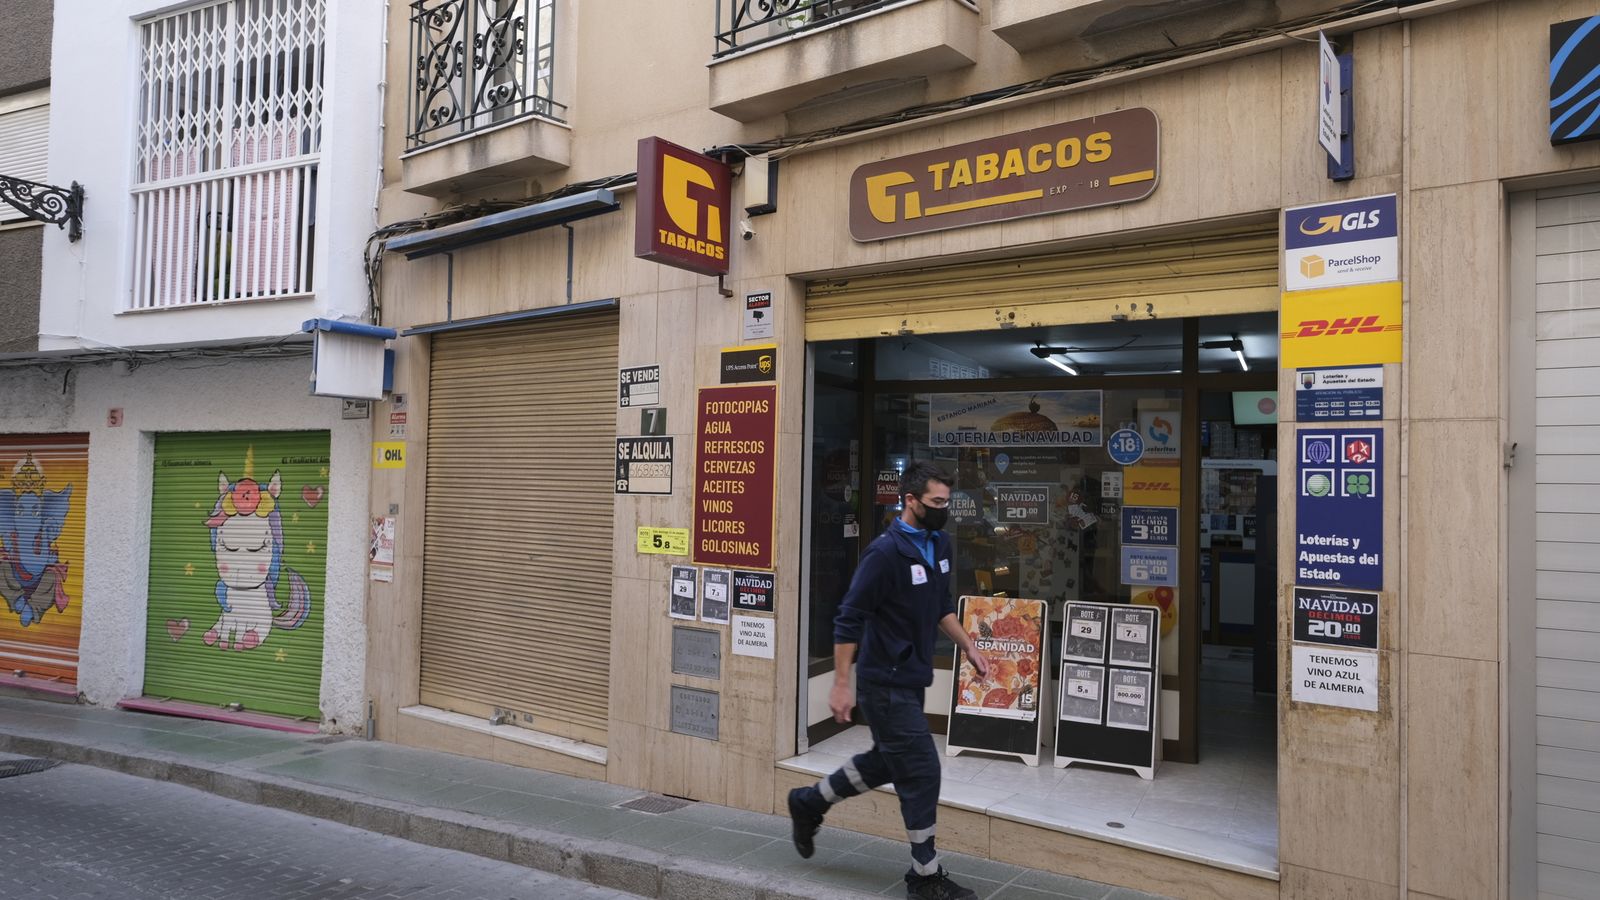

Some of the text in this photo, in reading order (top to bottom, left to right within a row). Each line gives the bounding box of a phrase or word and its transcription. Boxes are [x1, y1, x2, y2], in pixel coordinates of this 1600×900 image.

[928, 131, 1112, 191] TABACOS
[1050, 179, 1100, 196] EXP 18
[1342, 209, 1380, 231] GLS
[659, 229, 724, 260] TABACOS
[1328, 254, 1381, 267] ParcelShop
[748, 295, 769, 303] SECTOR
[1296, 315, 1385, 338] DHL
[760, 361, 771, 370] ups
[621, 368, 659, 384] SE VENDE
[706, 400, 768, 414] FOTOCOPIAS
[937, 398, 997, 422] ESTANCO MARIANA
[110, 409, 118, 425] 5
[647, 410, 657, 433] 7
[704, 421, 732, 434] AGUA
[937, 431, 1093, 443] LOTERIA DE NAVIDAD
[618, 441, 671, 461] SE ALQUILA
[704, 440, 765, 454] REFRESCOS
[1112, 437, 1136, 453] +18
[385, 449, 402, 461] OHL
[703, 461, 756, 474] CERVEZAS
[702, 480, 745, 494] ACEITES
[1131, 482, 1170, 491] DHL
[951, 497, 976, 509] TERÍA
[1000, 493, 1046, 502] NAVIDAD
[702, 500, 733, 513] VINOS
[949, 509, 977, 517] NAVIDAD
[702, 520, 745, 534] LICORES
[702, 539, 760, 555] GOLOSINAS
[1300, 534, 1360, 549] Loterías y
[1300, 551, 1378, 565] Apuestas del
[1300, 567, 1341, 580] Estado
[679, 585, 688, 593] 29
[735, 577, 773, 589] NAVIDAD
[1299, 598, 1374, 615] NAVIDAD
[1080, 610, 1095, 618] BOTE
[1125, 614, 1140, 622] BOTE
[1308, 610, 1361, 622] DECIMOS
[741, 621, 765, 629] TENEMOS
[1080, 626, 1092, 634] 29
[745, 639, 768, 648] ALMERIA
[974, 641, 1035, 653] ISPANIDAD
[1310, 655, 1358, 667] TENEMOS
[1077, 670, 1091, 678] BOTE
[1123, 675, 1137, 684] BOTE
[1307, 668, 1361, 681] VINO AZUL
[1304, 680, 1365, 695] DE ALMERIA
[1020, 693, 1033, 704] 15
